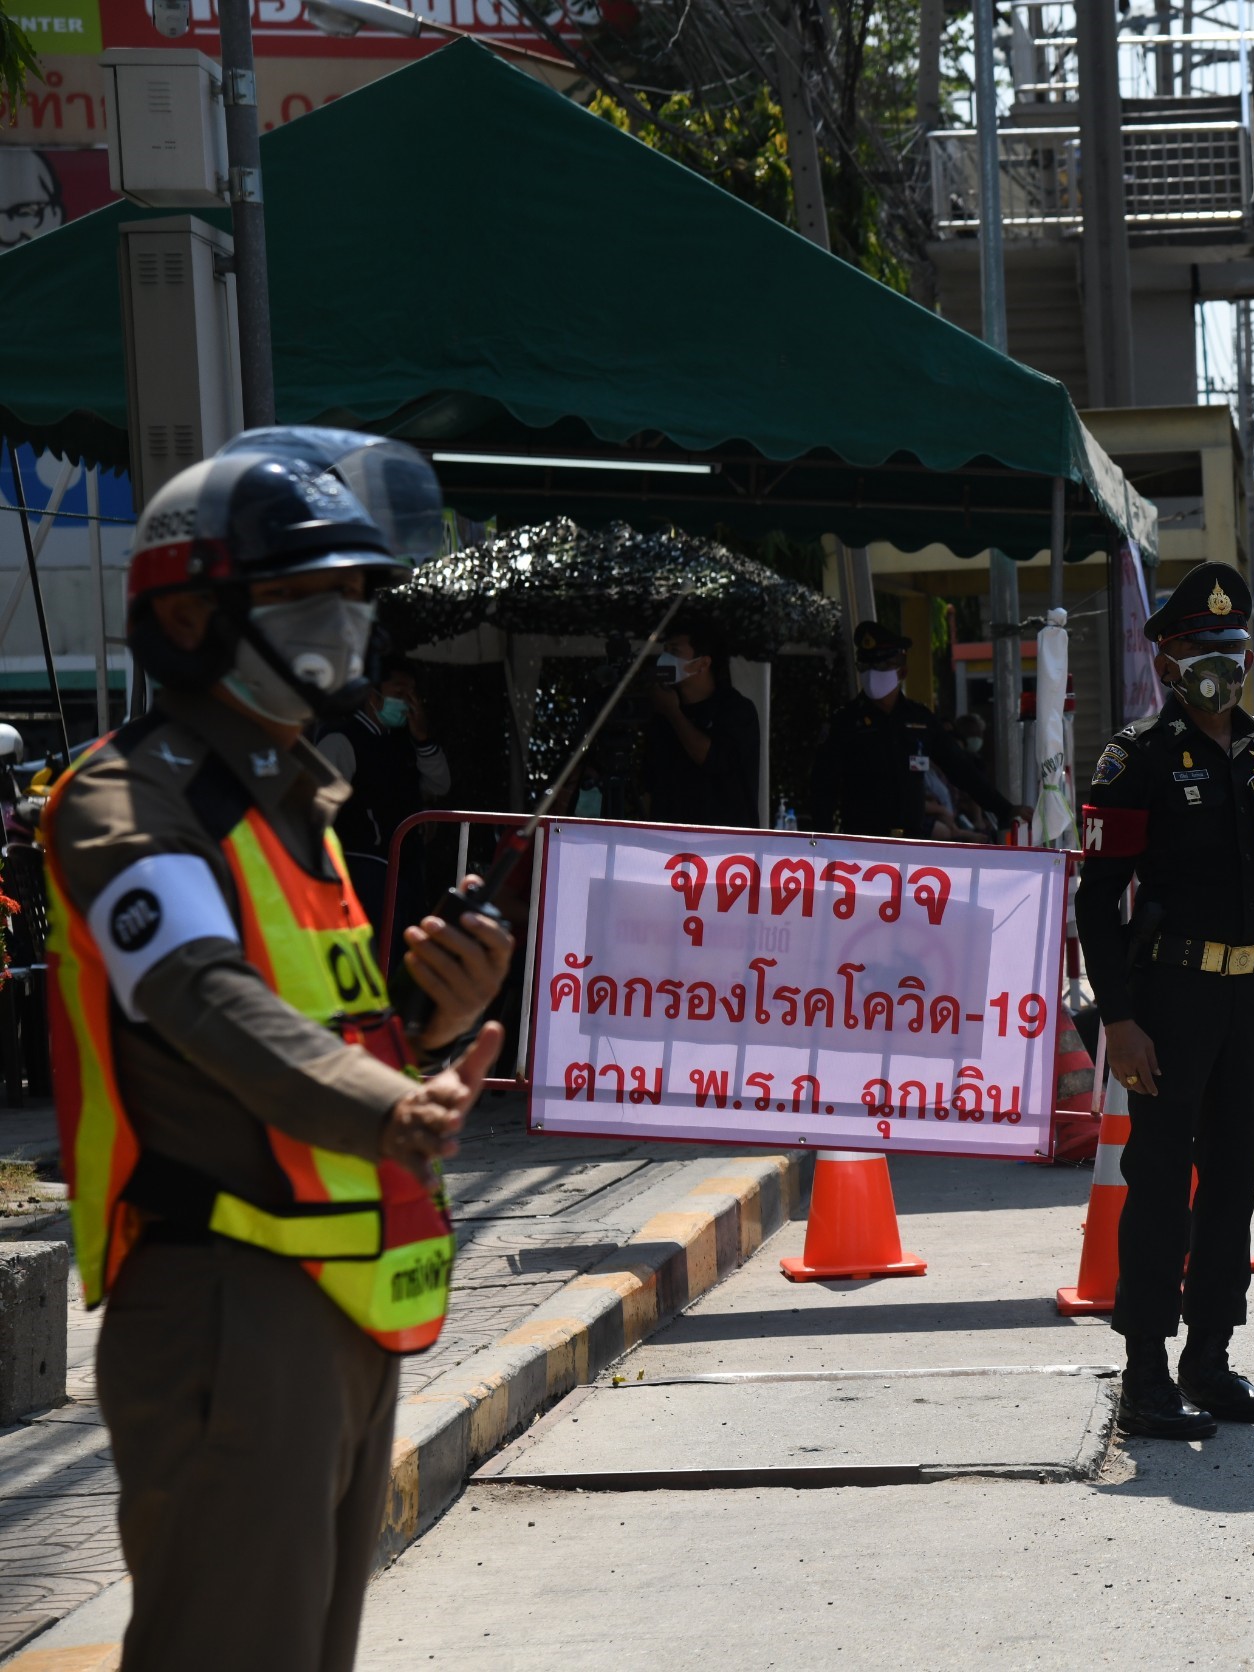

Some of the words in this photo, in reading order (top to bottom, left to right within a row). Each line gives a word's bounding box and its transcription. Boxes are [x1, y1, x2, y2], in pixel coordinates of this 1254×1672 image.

[664, 853, 952, 946] จุดตรวจ
[549, 952, 1048, 1039] คัดกรองโรคโควิด-19
[563, 1062, 663, 1104] ตาม
[689, 1067, 834, 1113] พ.ร.ก.
[860, 1065, 1022, 1140] ฉุกเฉิน
